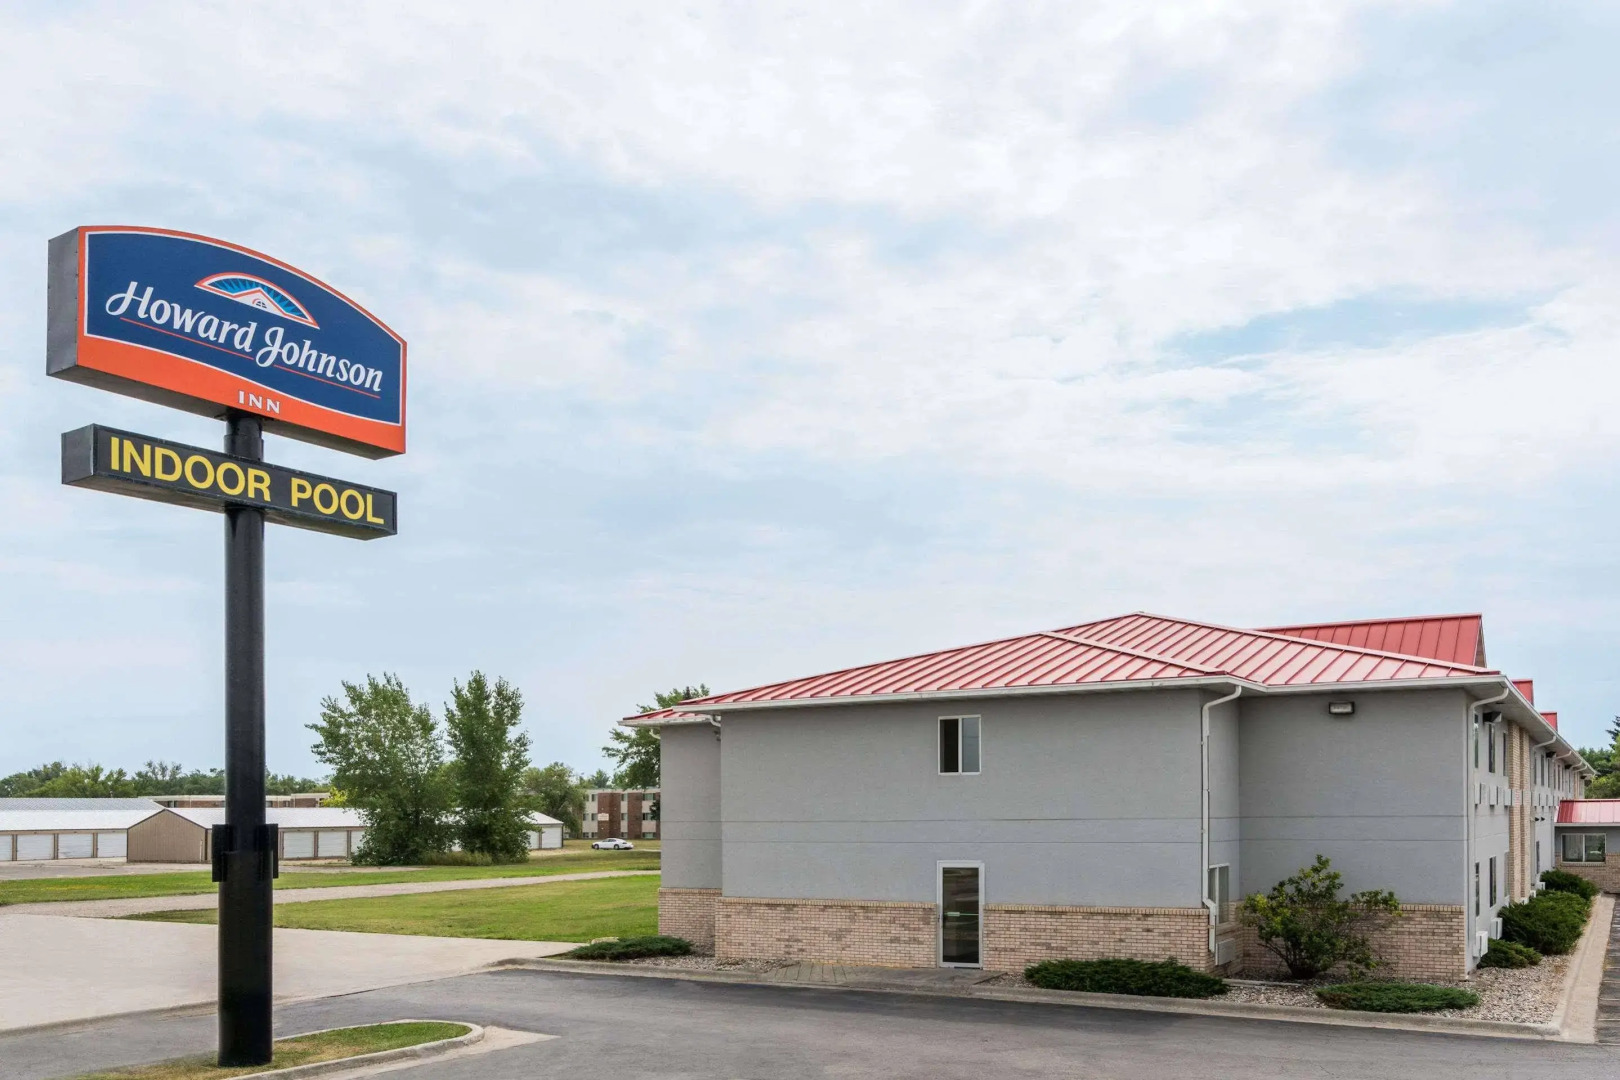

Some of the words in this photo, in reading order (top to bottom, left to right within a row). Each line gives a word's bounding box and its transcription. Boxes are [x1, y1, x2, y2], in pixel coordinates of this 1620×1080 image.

[106, 281, 257, 352] Howard
[256, 326, 384, 392] Johnson
[238, 390, 281, 414] INN
[110, 437, 271, 502] INDOOR
[291, 478, 385, 525] POOL
